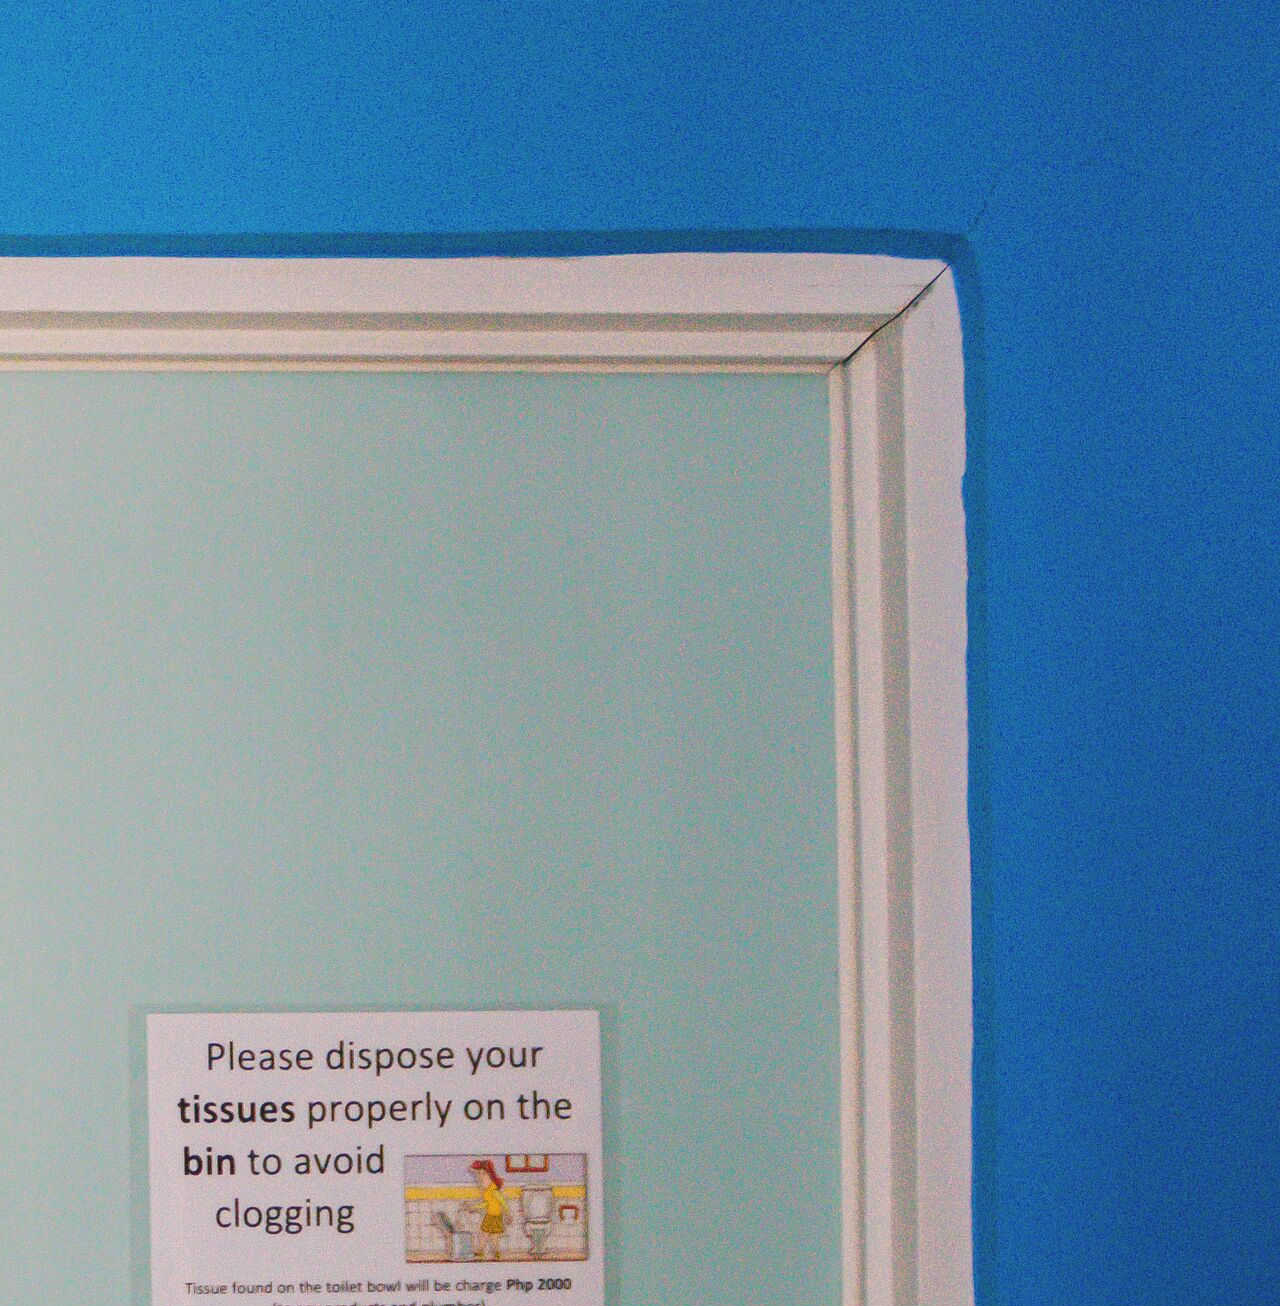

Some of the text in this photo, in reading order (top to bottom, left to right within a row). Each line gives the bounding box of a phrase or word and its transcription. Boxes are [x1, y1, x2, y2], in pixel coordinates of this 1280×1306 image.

[207, 1040, 544, 1077] Please dispose your
[177, 1090, 573, 1129] tissues properly on the
[183, 1144, 385, 1176] bin to avoid
[214, 1197, 355, 1236] clogging
[185, 1277, 573, 1296] Tissue found on the toilet bowl will be charge Php 2000
